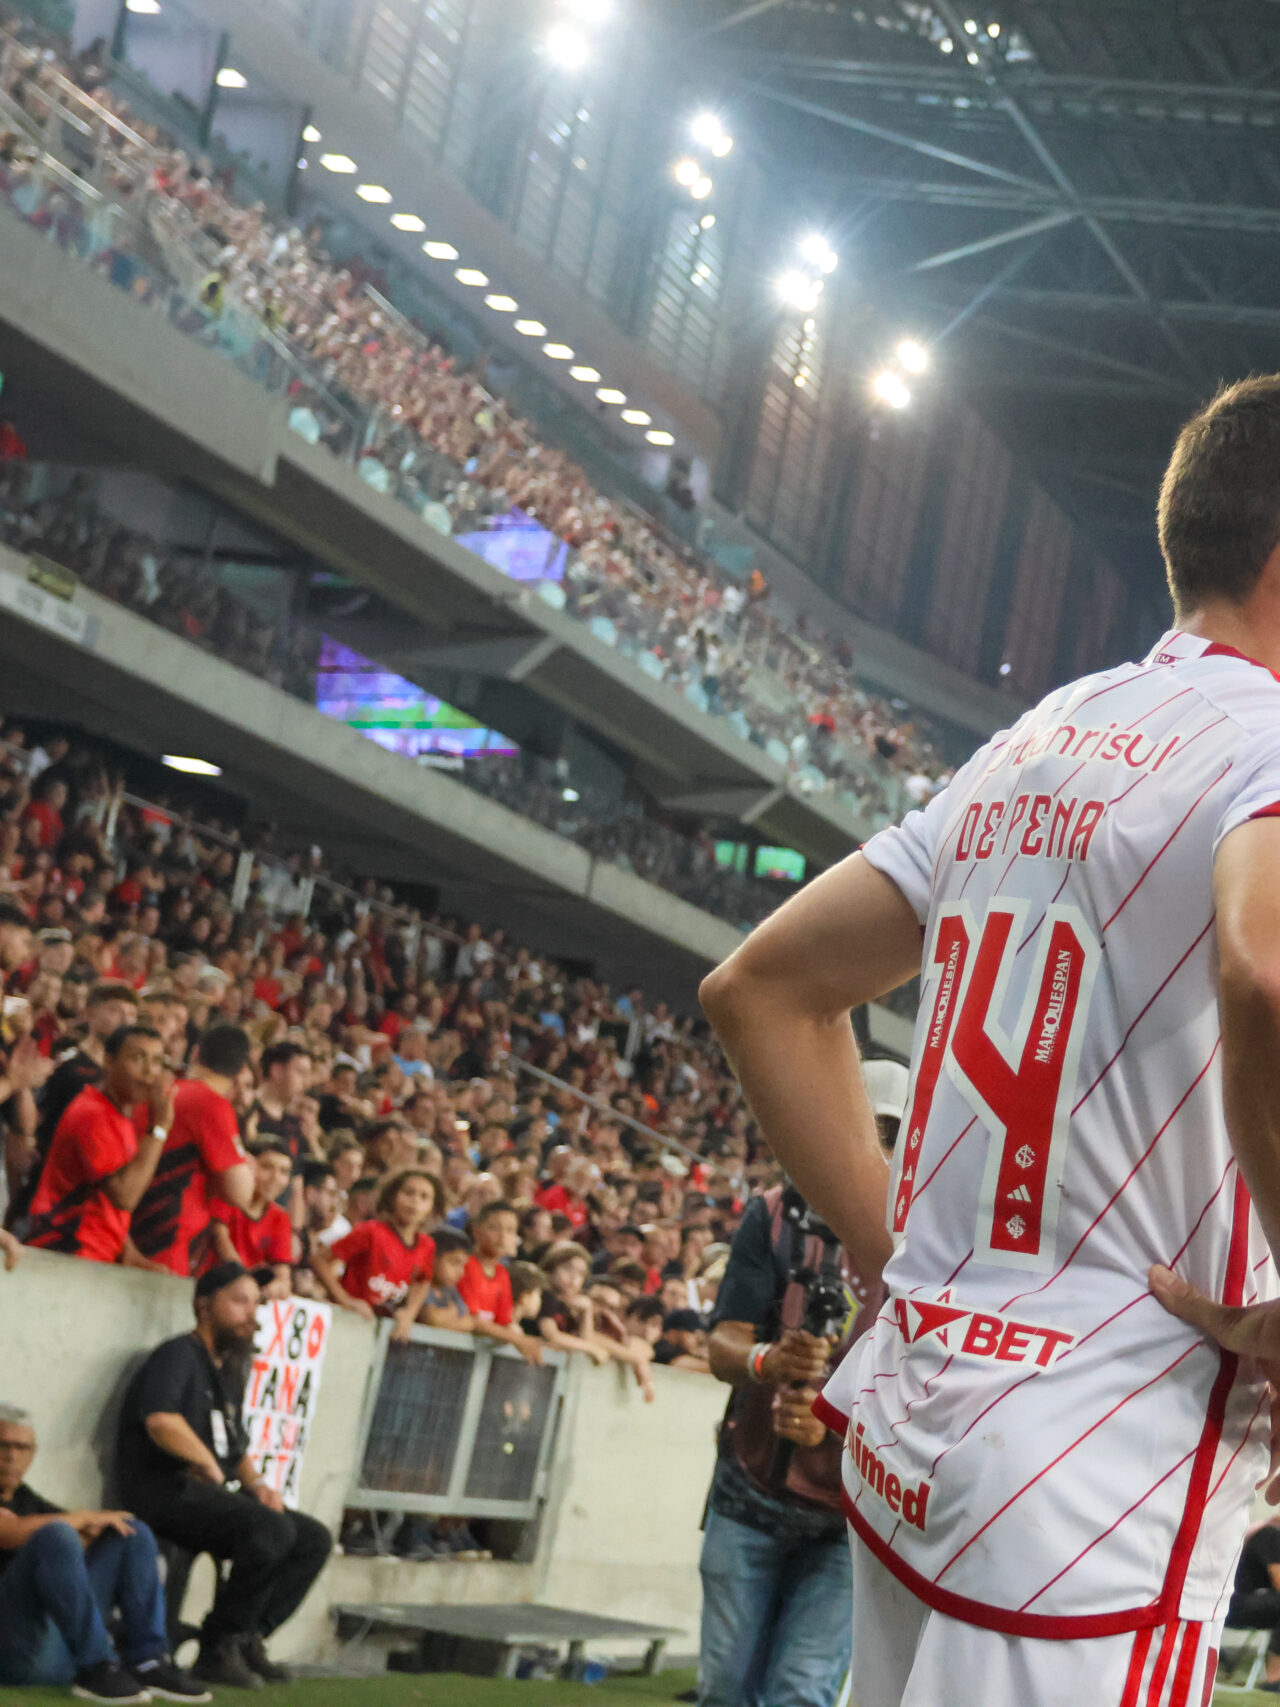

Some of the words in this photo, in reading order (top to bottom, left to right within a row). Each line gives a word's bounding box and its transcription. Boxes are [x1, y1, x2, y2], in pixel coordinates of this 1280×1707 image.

[955, 802, 1004, 861] DE
[1002, 795, 1105, 861] PENA
[1034, 950, 1071, 1064] MARQUESPAN
[892, 908, 1088, 1256] 14
[961, 1311, 1075, 1368] BET
